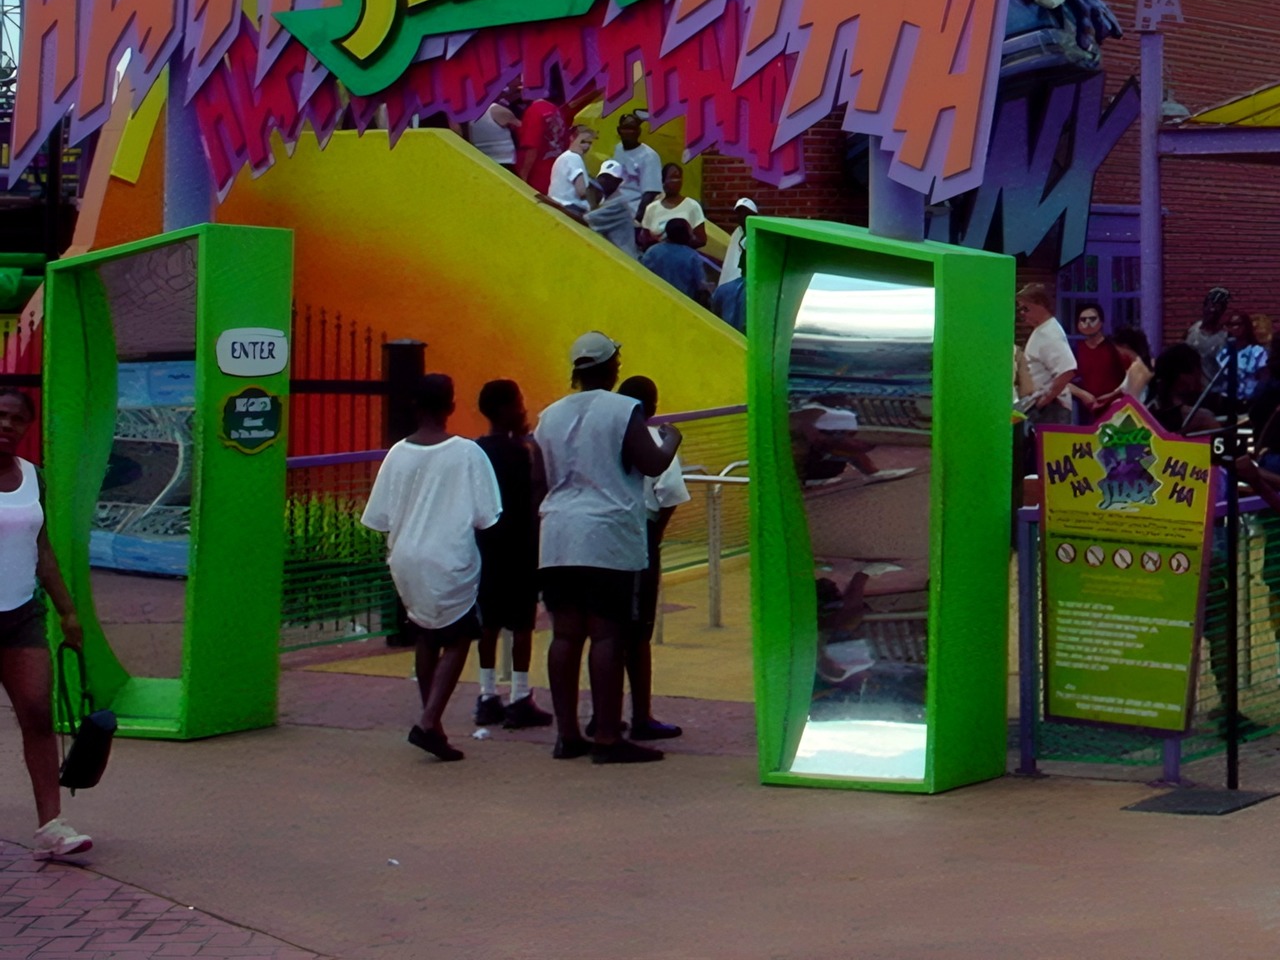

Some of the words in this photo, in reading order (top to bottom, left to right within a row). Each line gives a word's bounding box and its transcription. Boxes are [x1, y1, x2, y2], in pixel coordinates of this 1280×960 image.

[231, 341, 276, 360] ENTER
[1046, 455, 1078, 485] HA
[1162, 456, 1190, 482] HA
[1168, 481, 1195, 508] HA
